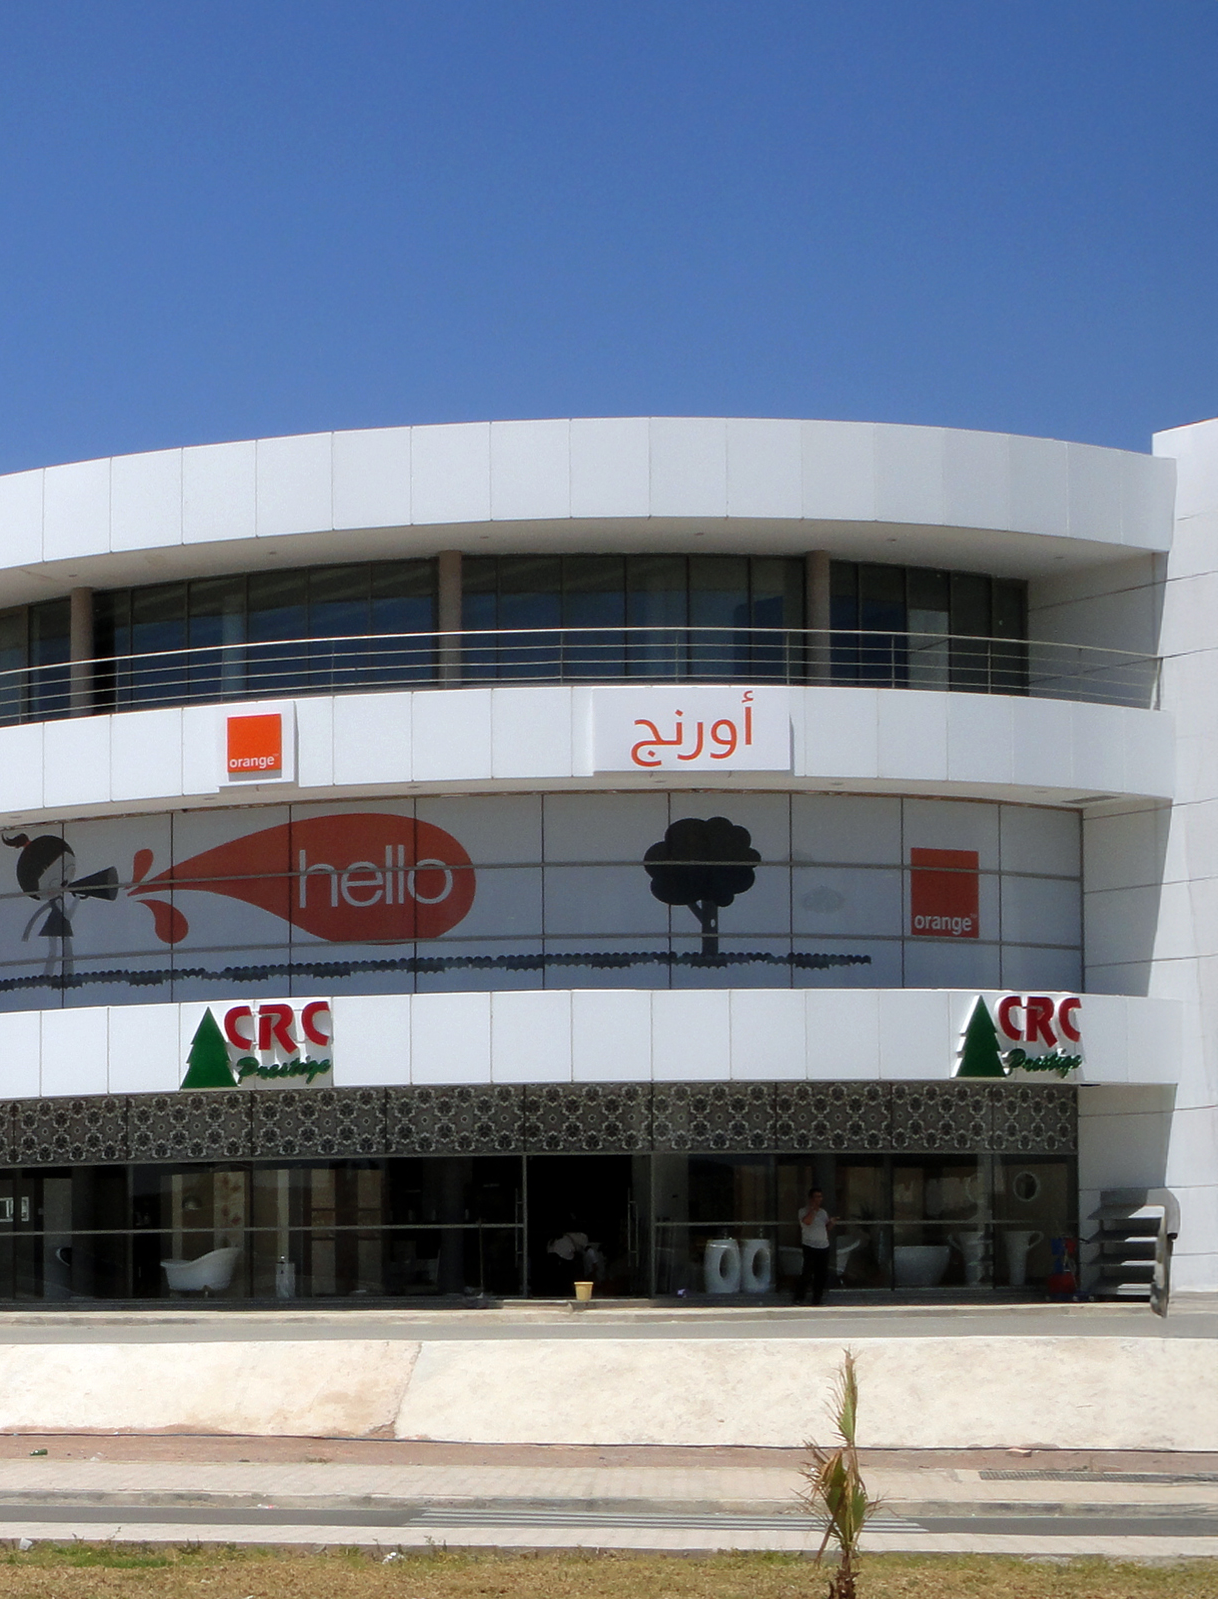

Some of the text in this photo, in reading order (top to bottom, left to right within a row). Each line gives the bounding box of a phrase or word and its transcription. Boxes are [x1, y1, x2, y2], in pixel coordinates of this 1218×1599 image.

[630, 690, 754, 767] أورنج
[229, 755, 275, 769] orange
[299, 845, 453, 908] hello
[914, 914, 971, 934] orange
[224, 1001, 330, 1054] CRC
[998, 996, 1081, 1048] CRC
[237, 1056, 331, 1085] Prestige
